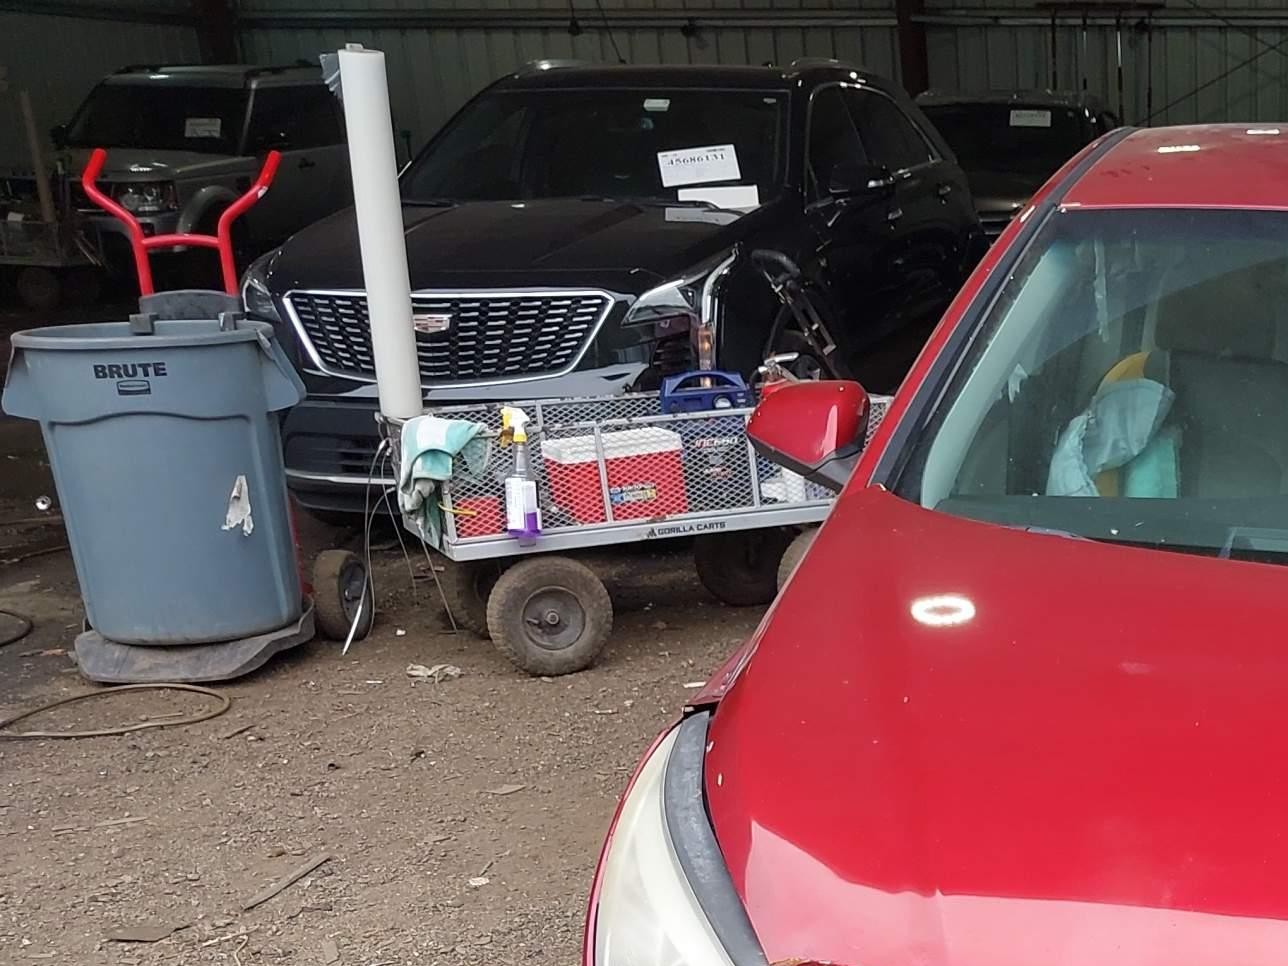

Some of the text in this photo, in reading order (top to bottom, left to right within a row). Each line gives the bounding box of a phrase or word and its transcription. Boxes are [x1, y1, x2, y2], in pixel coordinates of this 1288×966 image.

[93, 362, 168, 379] BRUTE
[657, 521, 726, 536] GORILLA CARTS
